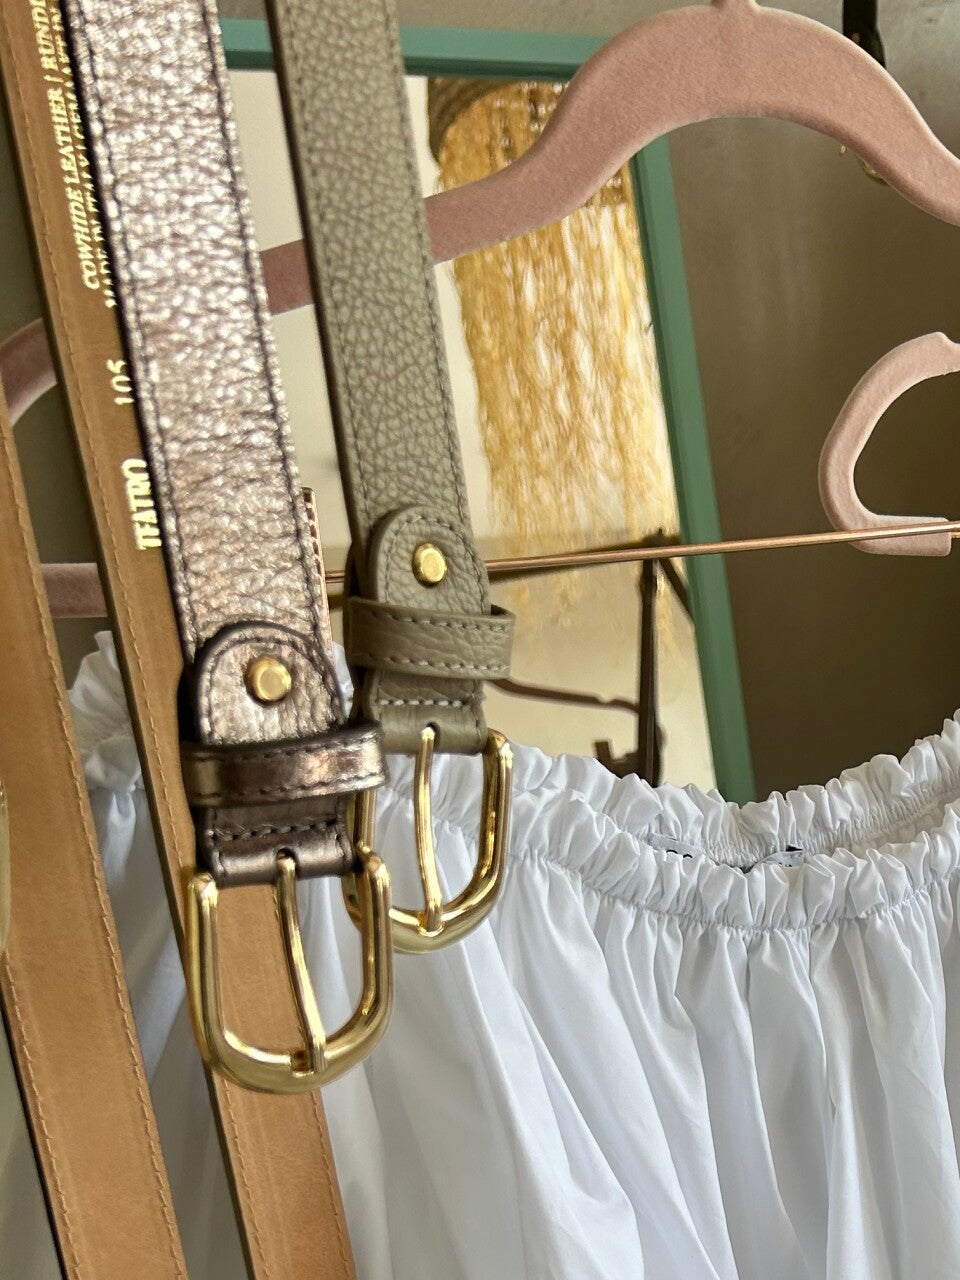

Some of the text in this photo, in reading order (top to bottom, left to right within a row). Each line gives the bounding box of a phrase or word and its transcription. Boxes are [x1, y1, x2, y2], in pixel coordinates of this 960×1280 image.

[47, 87, 80, 184] LEATHER
[65, 186, 100, 290] COWHIDE
[106, 358, 135, 405] 105
